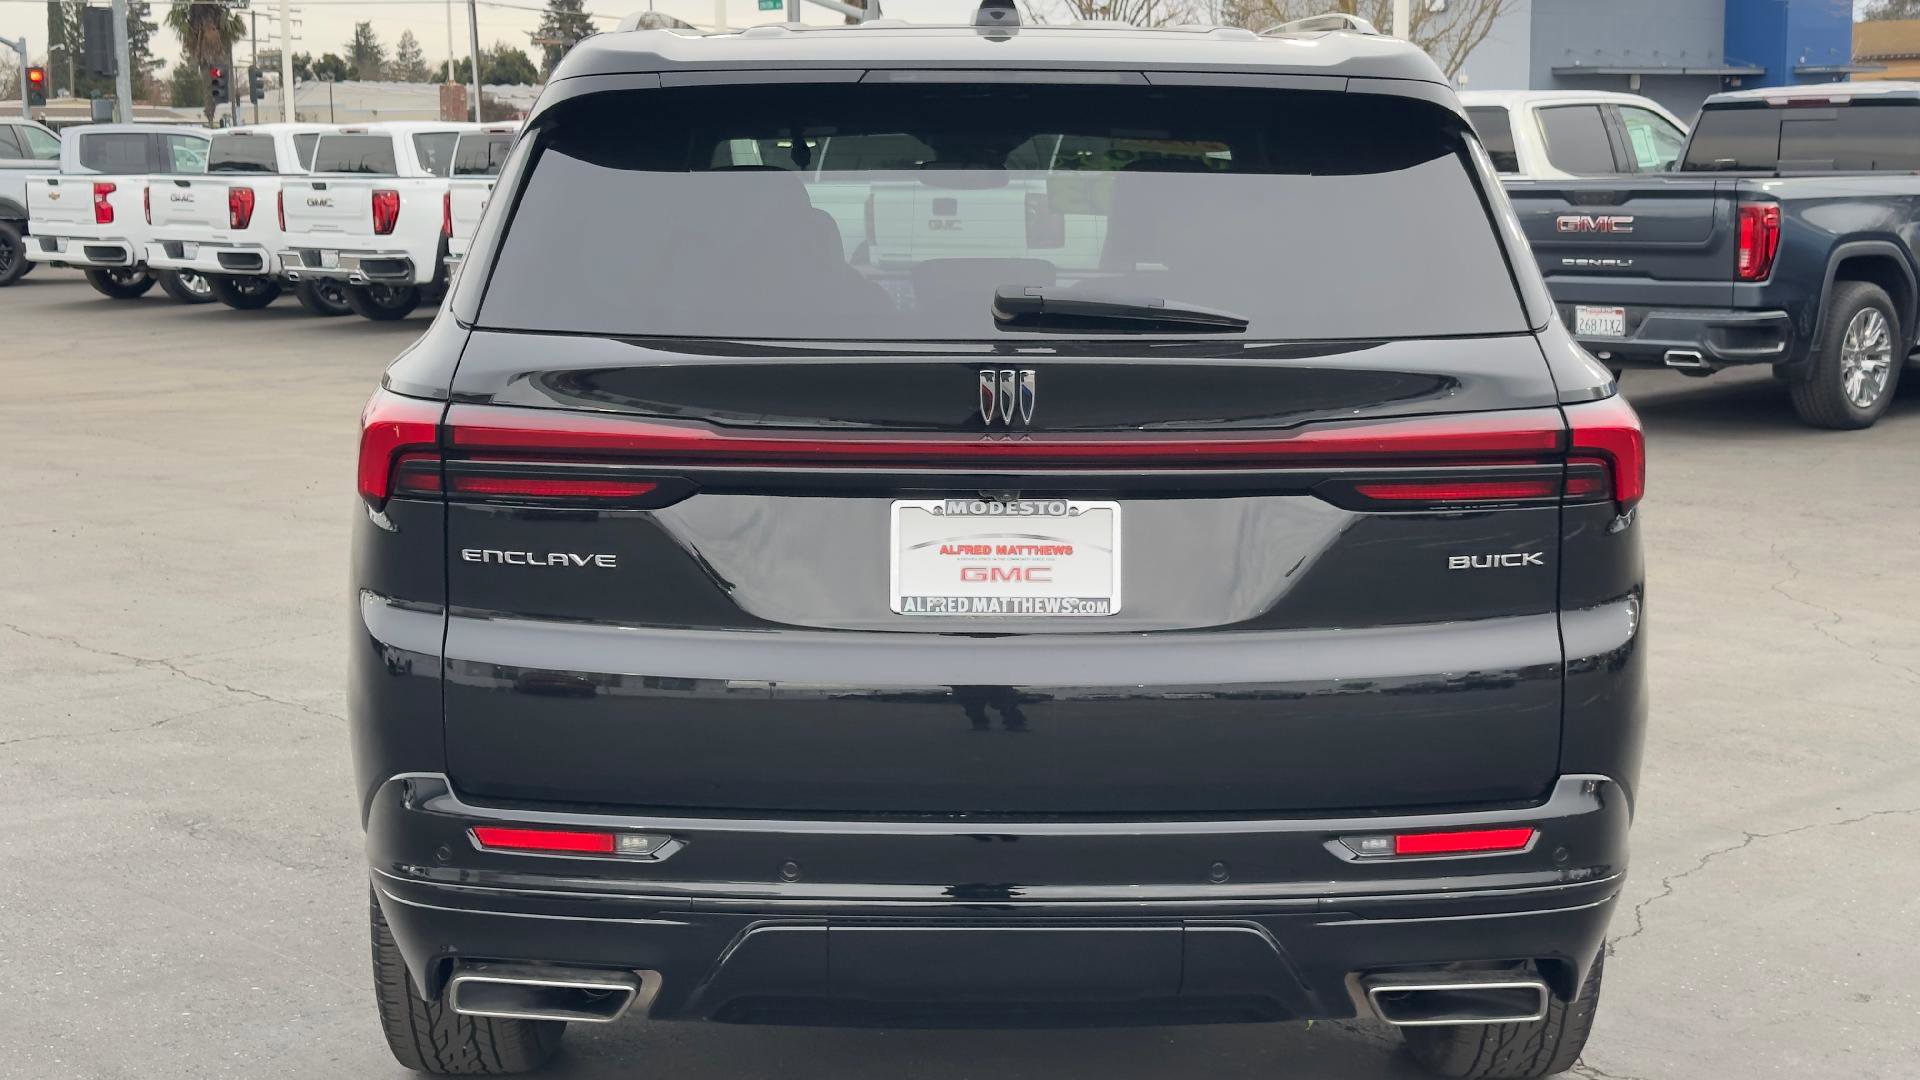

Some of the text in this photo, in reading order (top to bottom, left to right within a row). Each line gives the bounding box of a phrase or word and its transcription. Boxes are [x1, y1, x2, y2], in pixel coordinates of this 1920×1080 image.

[170, 193, 195, 203] GMC
[306, 197, 335, 208] GMC
[928, 219, 963, 231] GMC
[1556, 215, 1635, 233] GMC
[946, 501, 1066, 516] MODESTO
[939, 544, 1074, 556] ALFRED MATTHEWS
[461, 548, 617, 568] ENCLAVE
[1448, 551, 1545, 570] BUICK
[960, 566, 1054, 583] GMC
